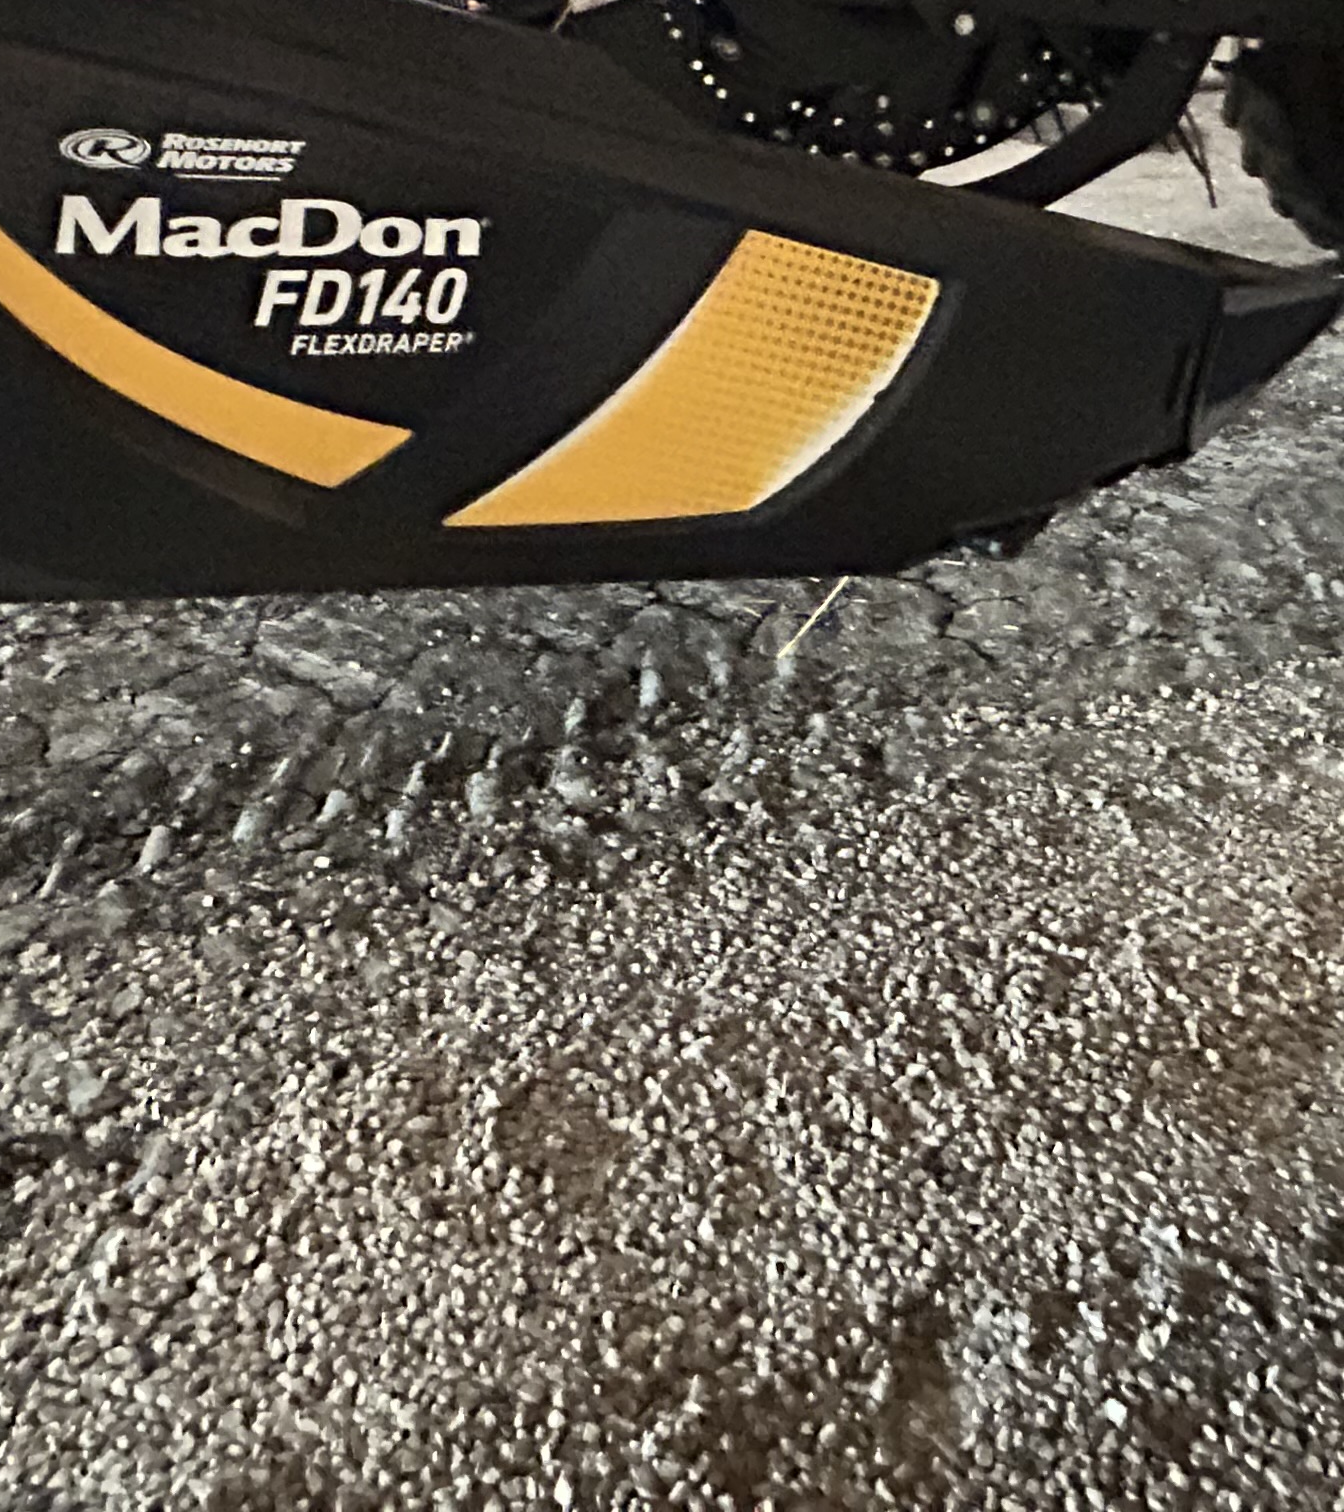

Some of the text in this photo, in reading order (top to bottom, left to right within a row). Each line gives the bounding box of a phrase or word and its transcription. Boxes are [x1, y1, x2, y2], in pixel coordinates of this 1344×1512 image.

[162, 133, 305, 154] ROSENORT
[157, 151, 294, 173] MOTORS
[56, 195, 481, 257] MacDon
[254, 268, 468, 326] FD140
[291, 333, 464, 356] FLEXDRAPER
